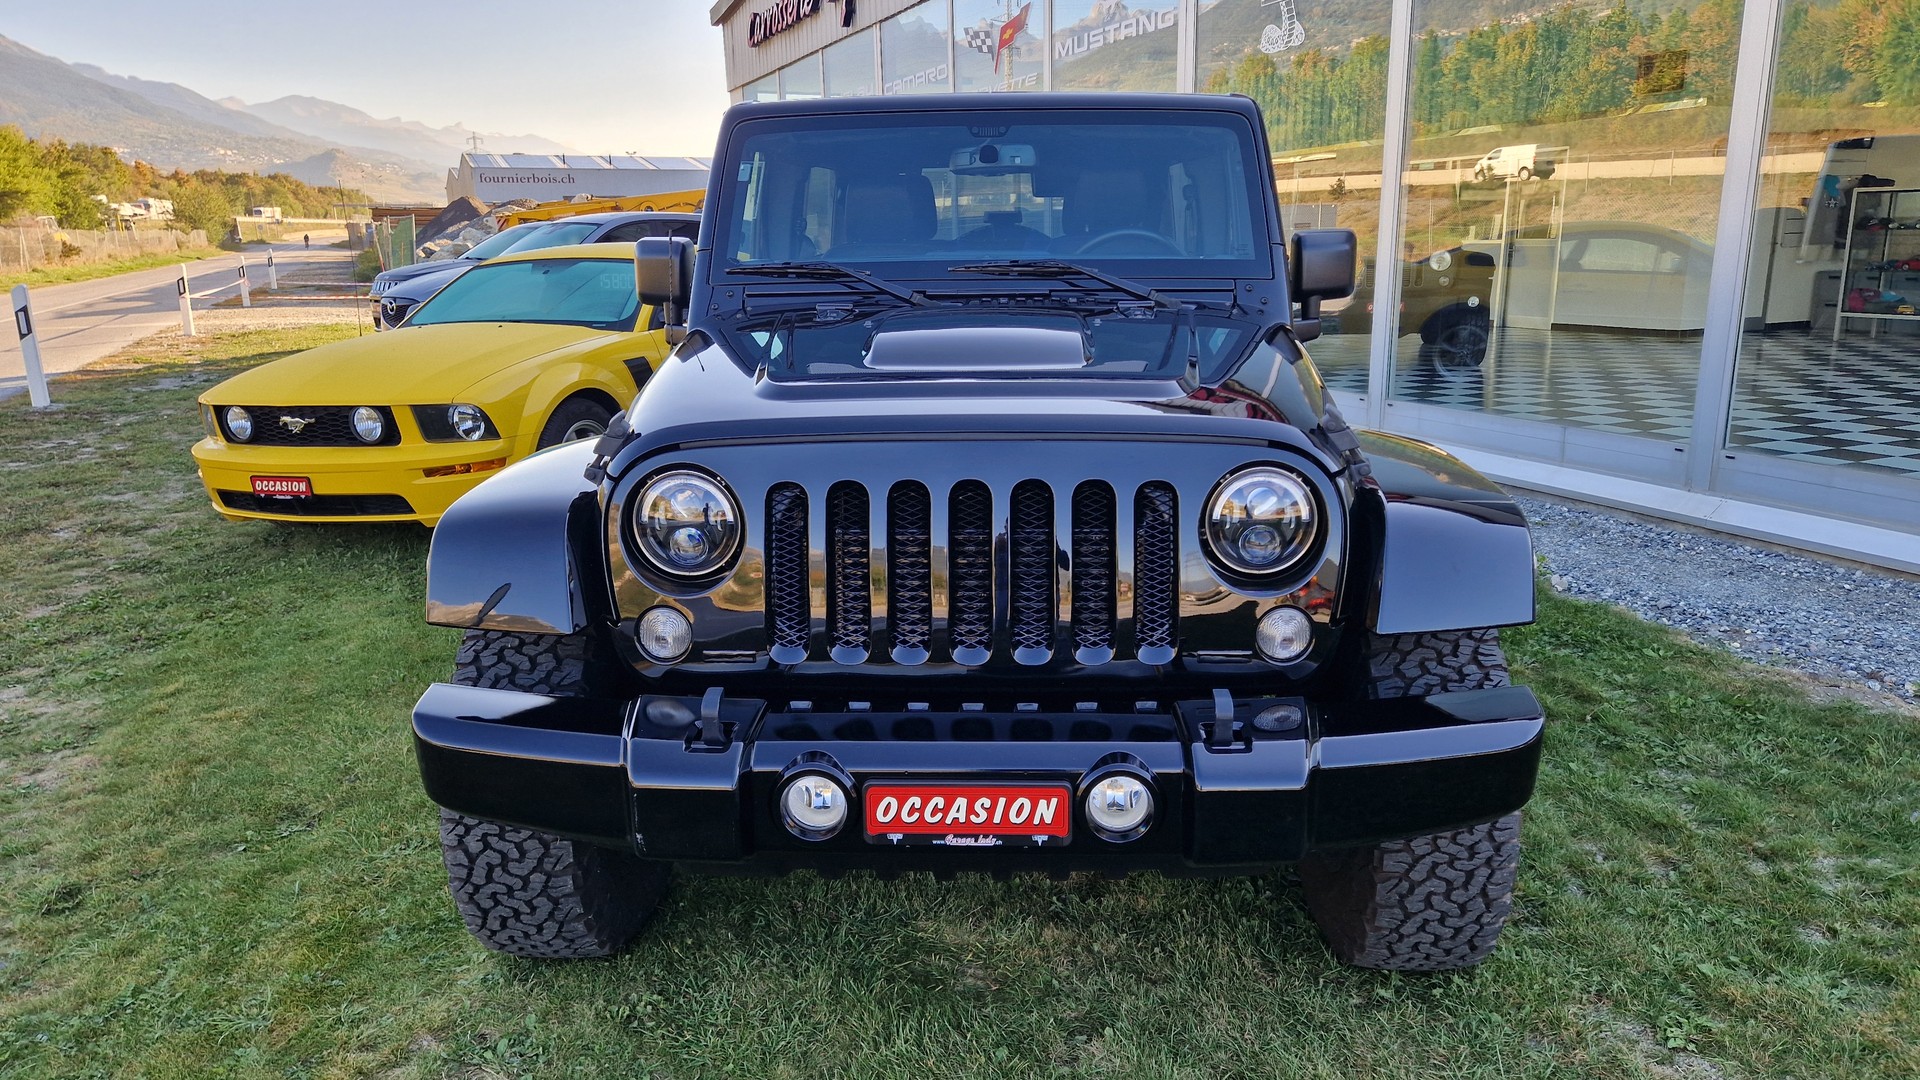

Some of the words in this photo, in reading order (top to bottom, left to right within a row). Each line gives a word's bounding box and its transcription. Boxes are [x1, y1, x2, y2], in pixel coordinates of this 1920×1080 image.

[1055, 10, 1176, 59] MUSTANG
[884, 63, 948, 95] CAMARO
[479, 172, 575, 184] fournierbois.ch
[255, 480, 306, 492] OCCASION
[876, 796, 1058, 825] OCCASION
